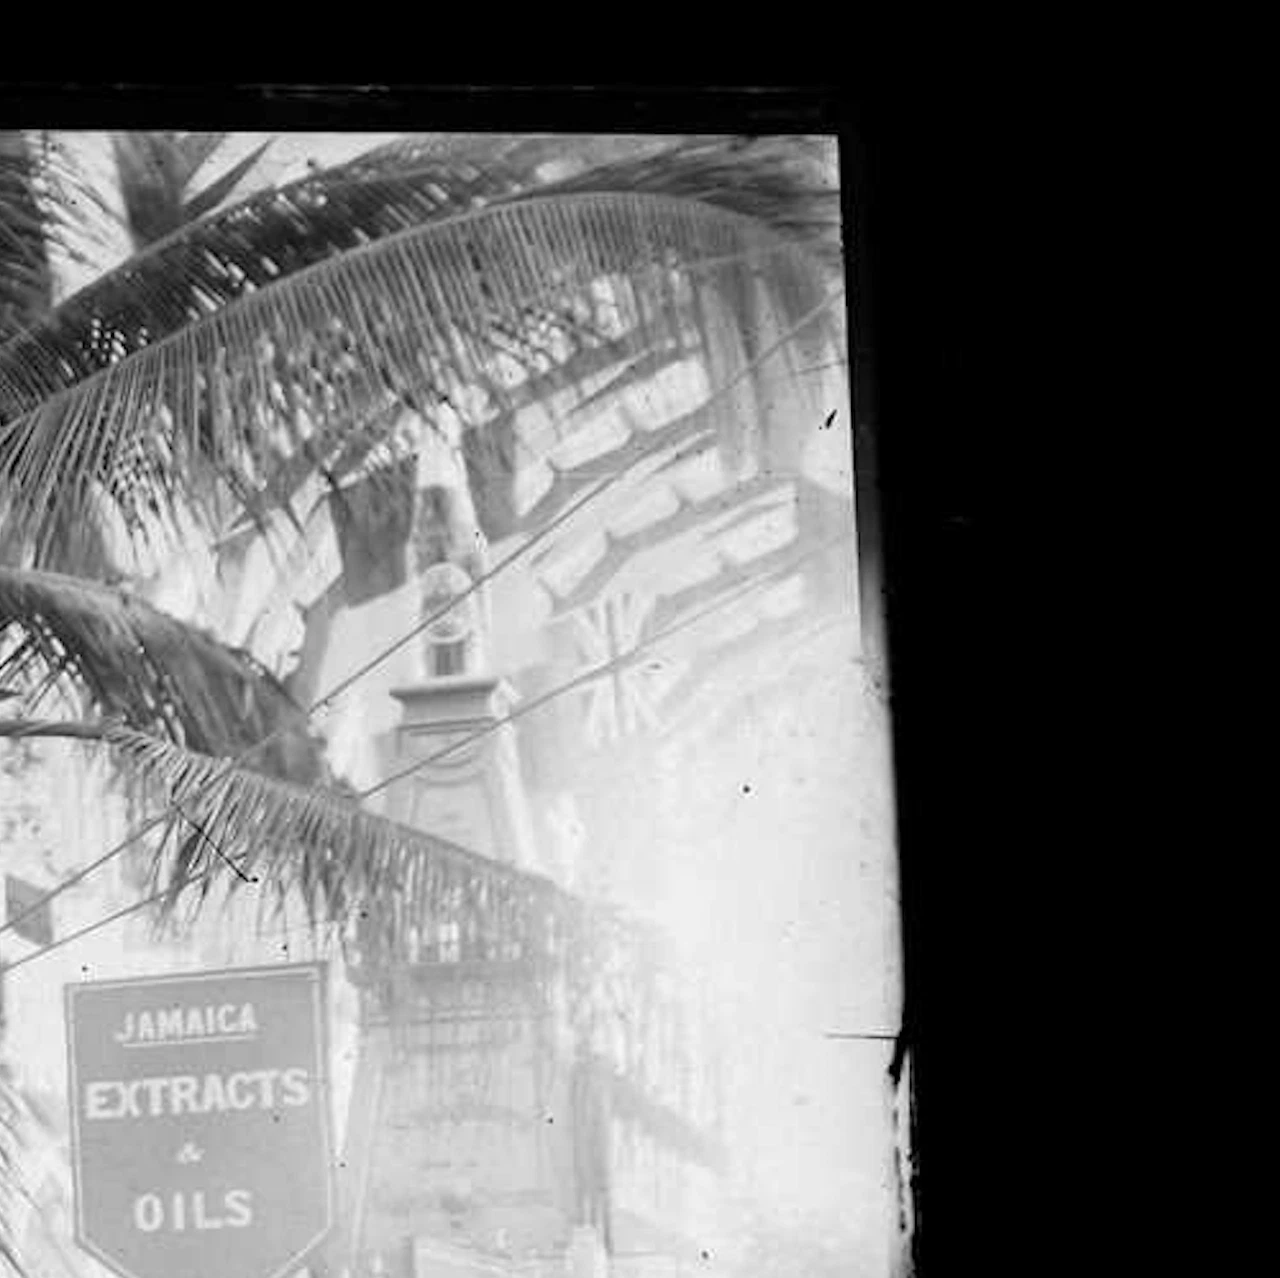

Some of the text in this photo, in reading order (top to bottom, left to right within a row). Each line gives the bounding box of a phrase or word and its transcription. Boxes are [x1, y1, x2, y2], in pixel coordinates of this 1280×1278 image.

[113, 1001, 257, 1043] JAMAICA
[86, 1067, 310, 1119] EXTRACTS
[176, 1141, 205, 1164] &
[134, 1189, 253, 1232] OILS
